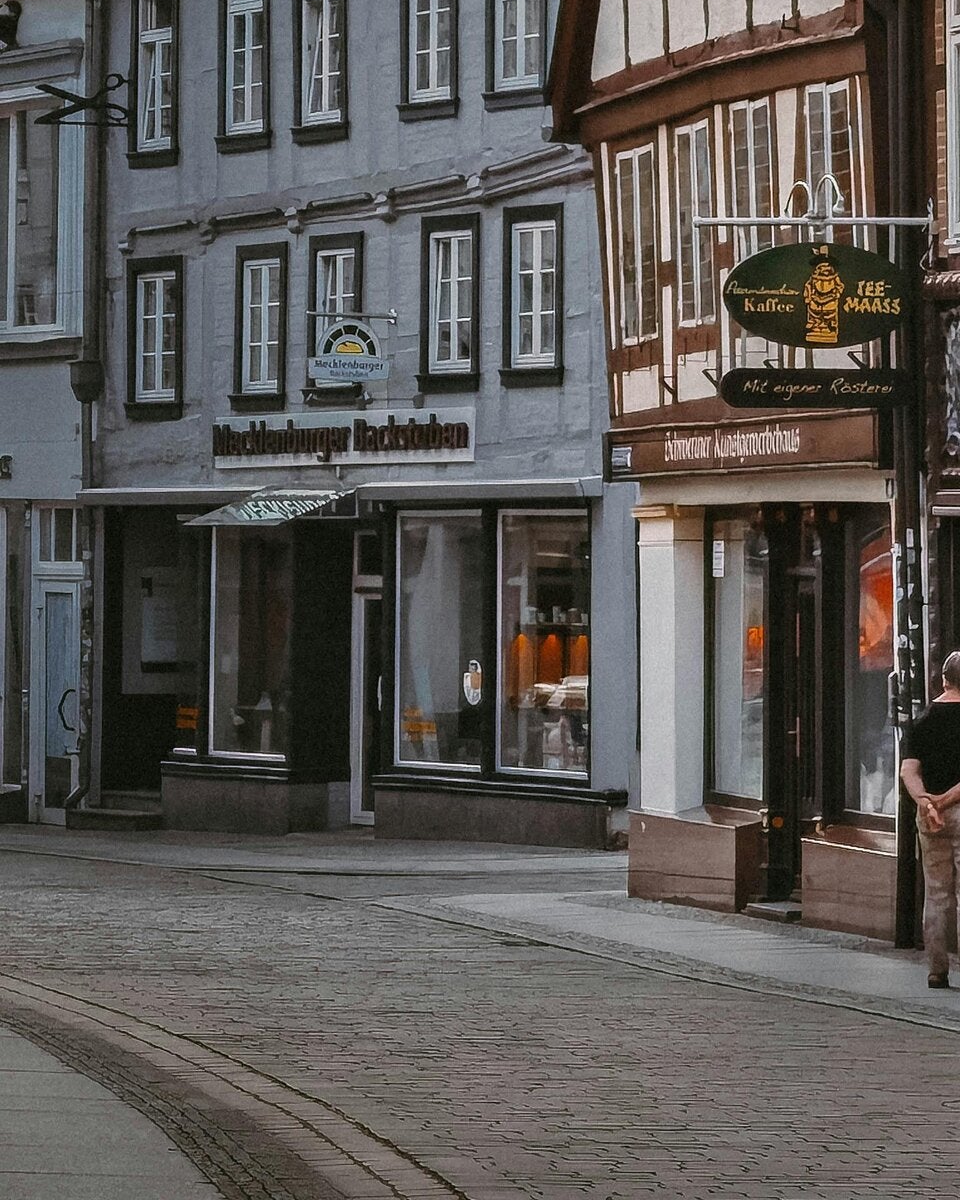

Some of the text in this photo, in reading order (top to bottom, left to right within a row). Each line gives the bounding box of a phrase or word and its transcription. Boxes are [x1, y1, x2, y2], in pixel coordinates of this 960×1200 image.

[744, 298, 795, 313] Kaffee
[843, 296, 901, 315] MAASS
[314, 359, 384, 373] Mecklenburger
[743, 378, 893, 401] Mit eigener Rösterei
[212, 413, 469, 462] Mecklenburger Backstuben
